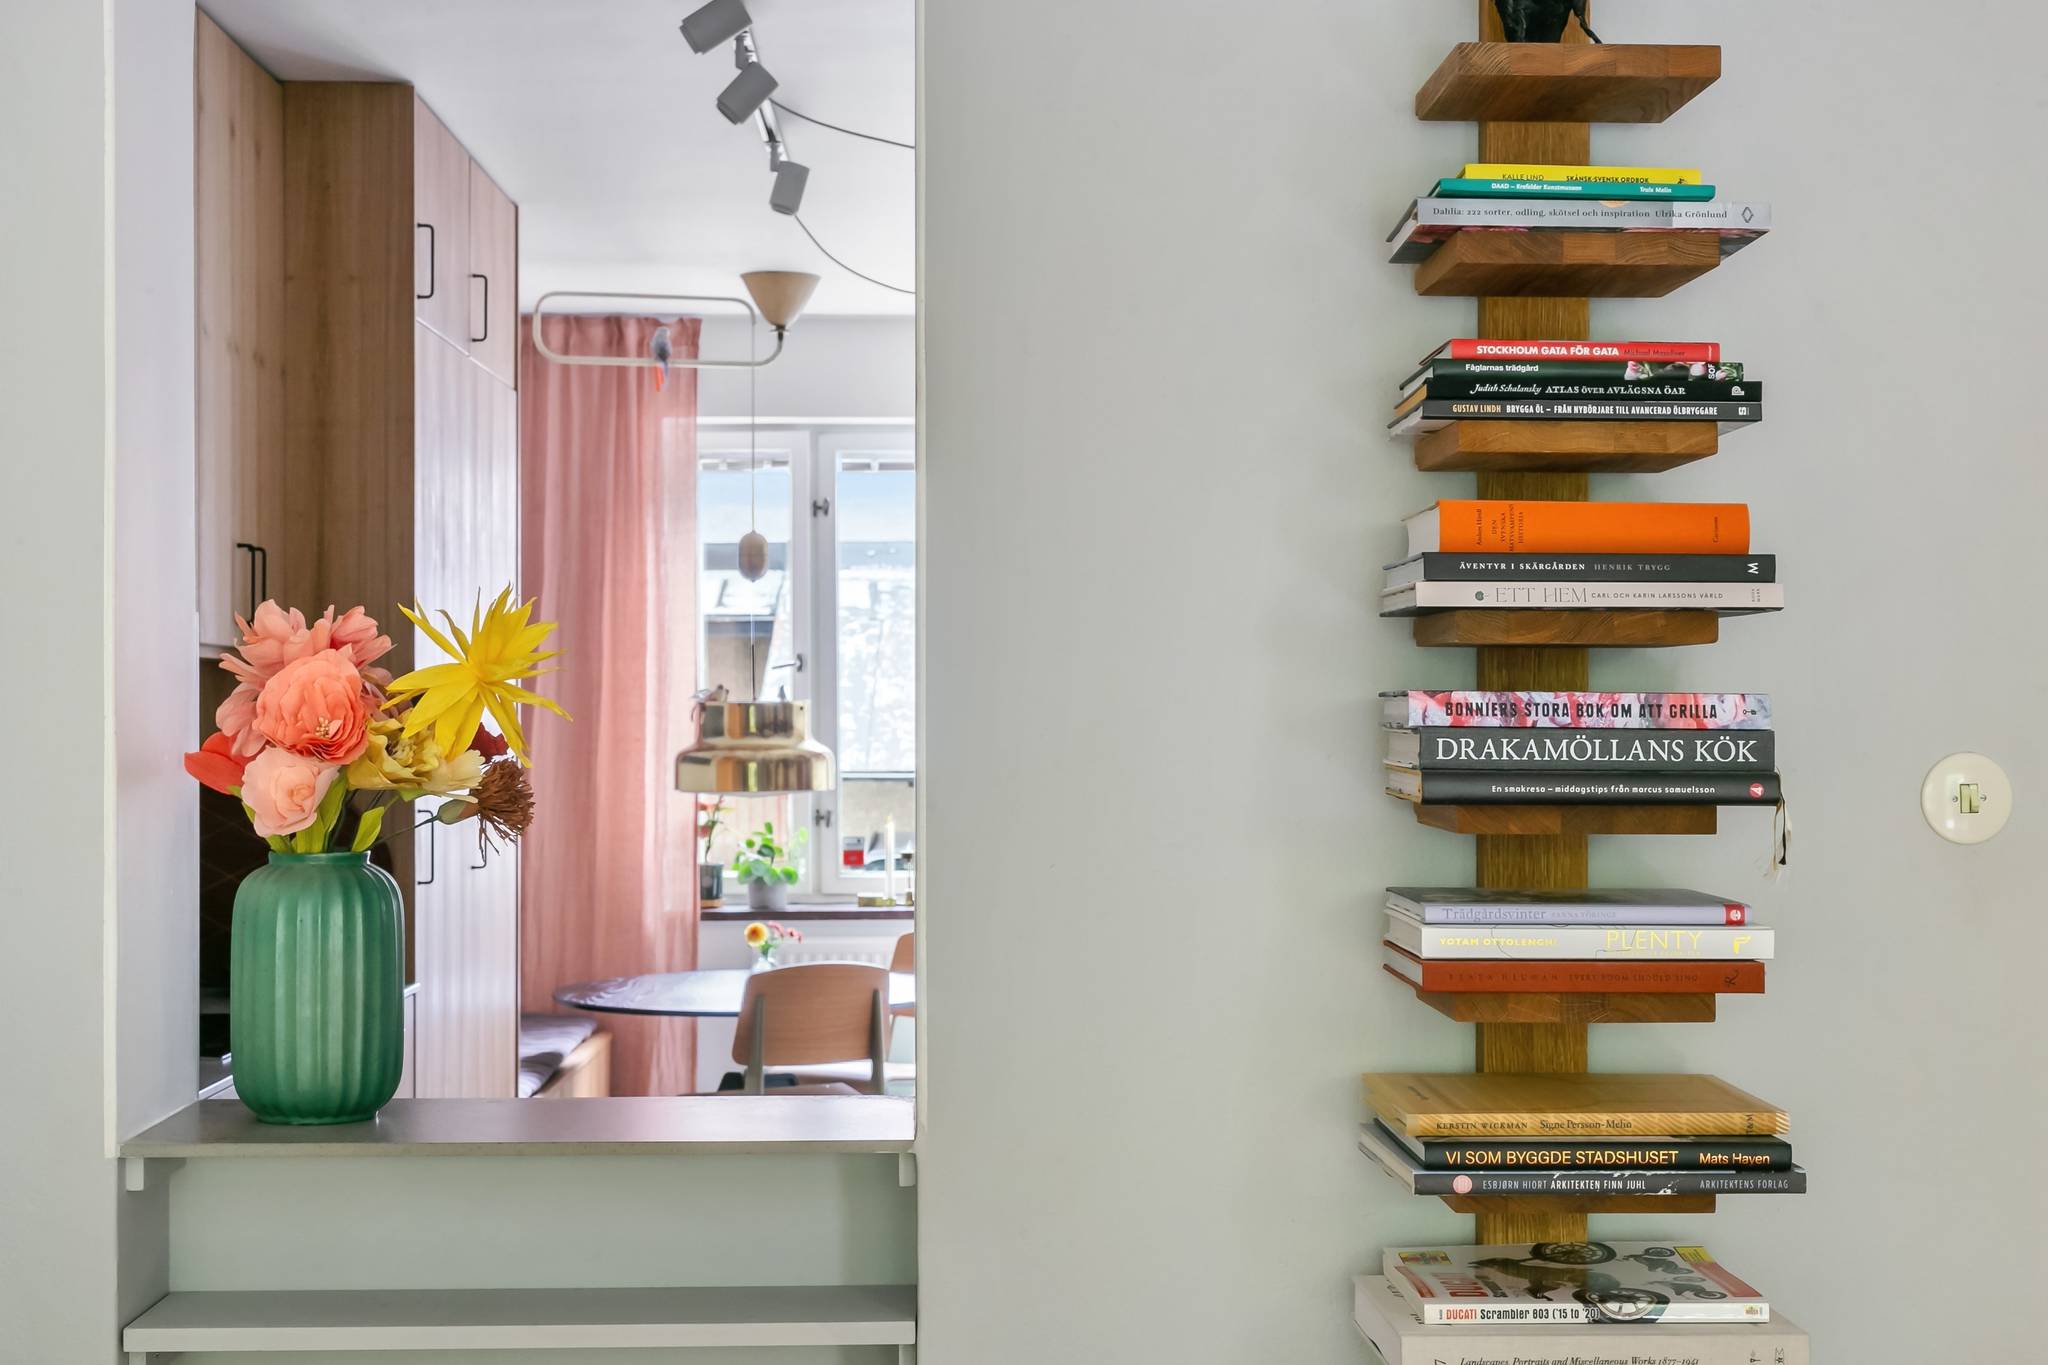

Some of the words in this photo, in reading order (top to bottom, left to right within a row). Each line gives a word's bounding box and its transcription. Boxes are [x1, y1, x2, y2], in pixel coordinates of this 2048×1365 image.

[1502, 173, 1526, 181] KALLE
[1526, 174, 1545, 182] LIND
[1620, 176, 1650, 185] ORDBOK
[1491, 182, 1510, 190] DAAD
[1433, 207, 1464, 216] Dahlia:
[1484, 208, 1513, 218] sorter,
[1515, 208, 1546, 218] odling,
[1548, 208, 1580, 217] skötsel
[1582, 208, 1599, 217] och
[1600, 208, 1650, 219] inspiration
[1655, 209, 1683, 218] Ulrika
[1685, 210, 1728, 219] Grönlund
[1476, 345, 1539, 355] STOCKHOLM
[1541, 346, 1568, 356] GATA
[1570, 344, 1590, 356] FÖR
[1592, 346, 1620, 356] GATA
[1465, 363, 1504, 373] Fåglarnas
[1505, 364, 1540, 373] trädgård
[1469, 383, 1499, 394] Judith
[1499, 383, 1542, 395] Schalansky
[1545, 385, 1580, 394] ATLAS
[1606, 385, 1662, 395] AVLÄGSNA
[1664, 385, 1687, 395] ÖAR
[1452, 404, 1479, 413] GUSTAV
[1480, 404, 1501, 413] LINDH
[1506, 404, 1534, 414] BRYGGA
[1535, 403, 1545, 414] ÖL
[1554, 404, 1572, 414] FRÅN
[1573, 404, 1614, 414] NYBÖRJARE
[1616, 405, 1630, 415] TILL
[1631, 405, 1671, 415] AVANCERAD
[1673, 404, 1718, 415] ÖLBRYGGARE
[1460, 561, 1506, 570] ÄVENTYR
[1511, 562, 1515, 570] I
[1519, 561, 1585, 571] SKÄRGÅRDEN
[1594, 562, 1633, 571] HENRIK
[1637, 563, 1671, 571] TRYGG
[1495, 587, 1536, 603] ETT
[1543, 587, 1587, 603] HEM
[1699, 591, 1724, 599] VÄRLD
[1445, 702, 1518, 717] BONNIERS
[1524, 703, 1570, 717] STORA
[1576, 703, 1604, 718] BOK
[1610, 703, 1632, 718] OM
[1638, 703, 1663, 719] ATT
[1669, 704, 1718, 719] GRILLA
[1436, 734, 1685, 763] DRAKAMÖLLANS
[1694, 735, 1758, 763] KÖK
[1491, 785, 1502, 793] En
[1610, 784, 1630, 794] från
[1632, 786, 1662, 794] marcus
[1664, 785, 1715, 794] samuelsson
[1442, 907, 1547, 922] Trädgårdsvinter
[1440, 938, 1479, 946] YOTAM
[1483, 938, 1558, 946] OTTOLENGHI
[1605, 929, 1703, 950] PLENTY
[1436, 1121, 1477, 1130] KERSTIN
[1481, 1121, 1528, 1130] WICKMAN
[1539, 1119, 1565, 1133] Signe
[1567, 1119, 1632, 1130] Persson-Melin
[1445, 1151, 1461, 1165] VI
[1465, 1151, 1501, 1165] SOM
[1506, 1151, 1572, 1165] BYGGDE
[1575, 1150, 1678, 1165] STADSHUSET
[1699, 1152, 1729, 1165] Mats
[1732, 1153, 1770, 1165] Haven
[1482, 1180, 1519, 1190] ESBJØRN
[1522, 1180, 1547, 1190] HIORT
[1550, 1180, 1600, 1190] ARKITEKTEN
[1603, 1180, 1623, 1190] FINN
[1626, 1180, 1646, 1190] JUHL
[1699, 1179, 1755, 1190] ARKITEKTENS
[1757, 1179, 1789, 1189] FORLAG
[1446, 1308, 1478, 1320] DUCATI
[1480, 1308, 1530, 1320] Scrambler
[1532, 1308, 1550, 1320] 803
[1552, 1308, 1568, 1321] ('15
[1570, 1308, 1580, 1320] to
[1512, 1357, 1550, 1365] Portraits
[1552, 1357, 1568, 1365] and
[1570, 1357, 1629, 1365] Miscellaneous
[1631, 1357, 1657, 1365] Works
